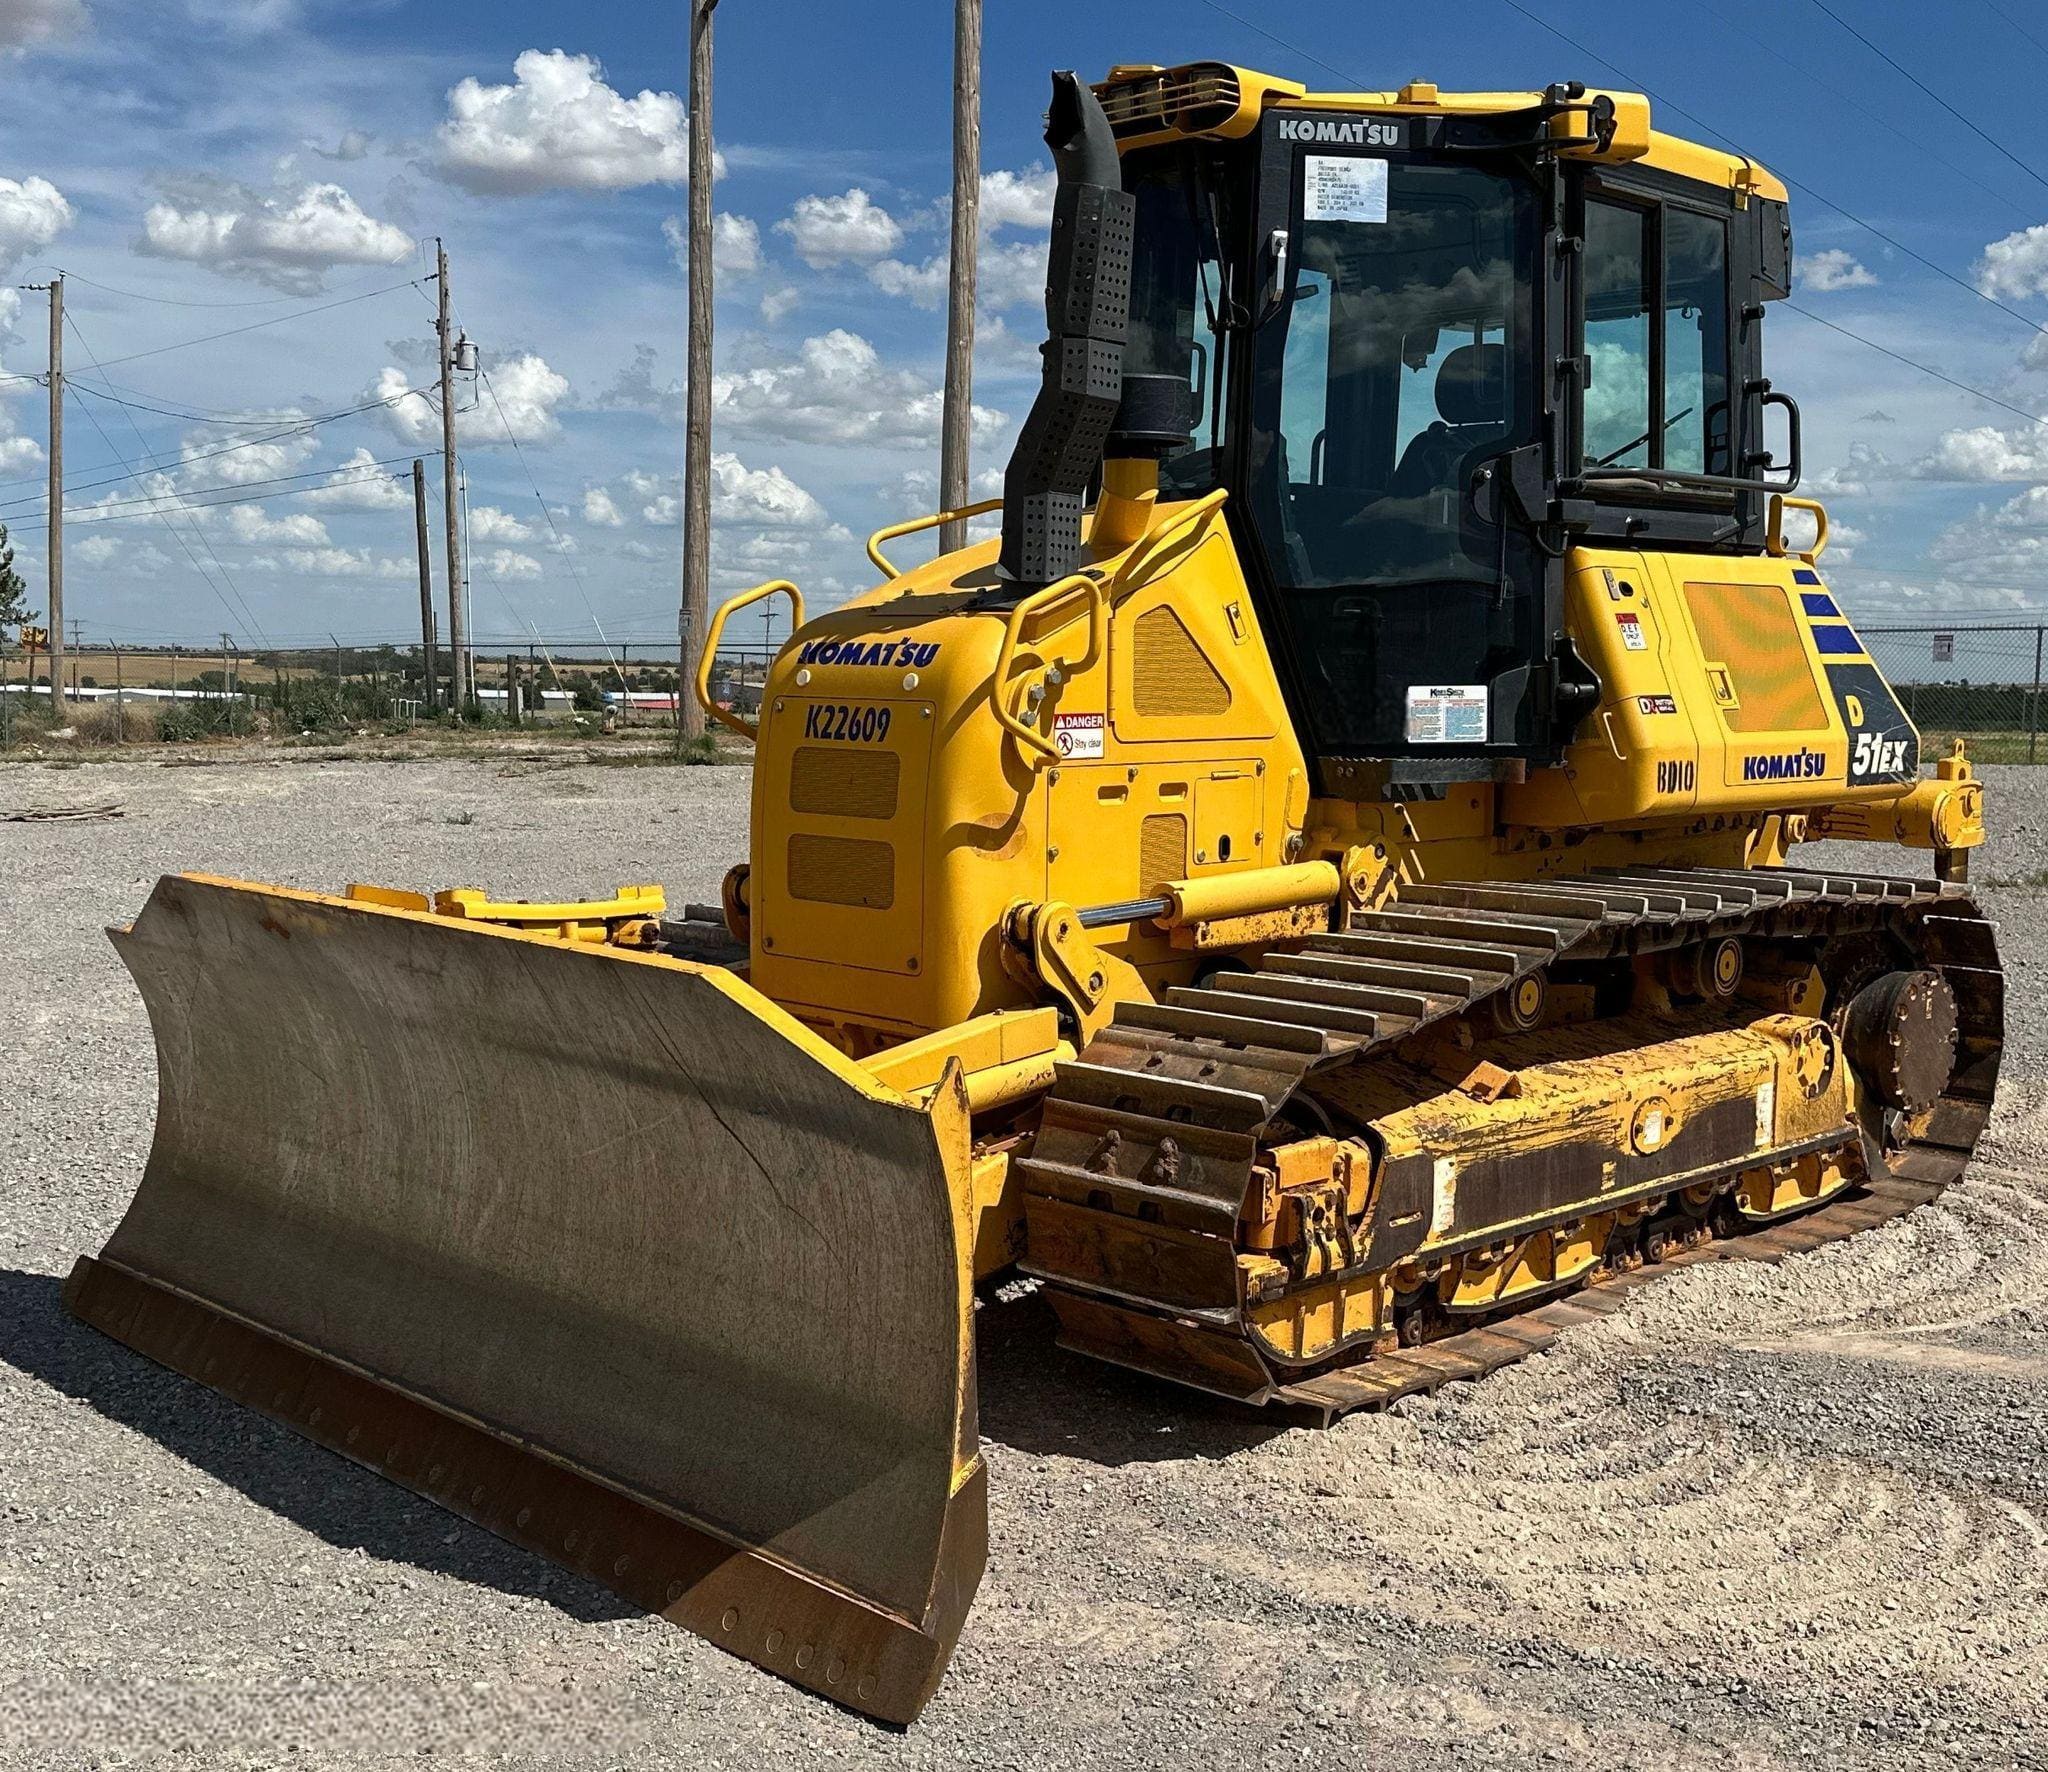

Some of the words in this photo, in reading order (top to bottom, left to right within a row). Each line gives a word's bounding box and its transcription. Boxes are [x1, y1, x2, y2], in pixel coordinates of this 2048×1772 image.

[1279, 119, 1399, 146] KOMATSU
[797, 636, 943, 668] KOMATSU
[804, 703, 892, 743] K22609
[1065, 715, 1104, 729] DANGER
[1845, 695, 1865, 727] D
[1743, 747, 1826, 780] KOMATSU
[1852, 732, 1909, 777] 51EX
